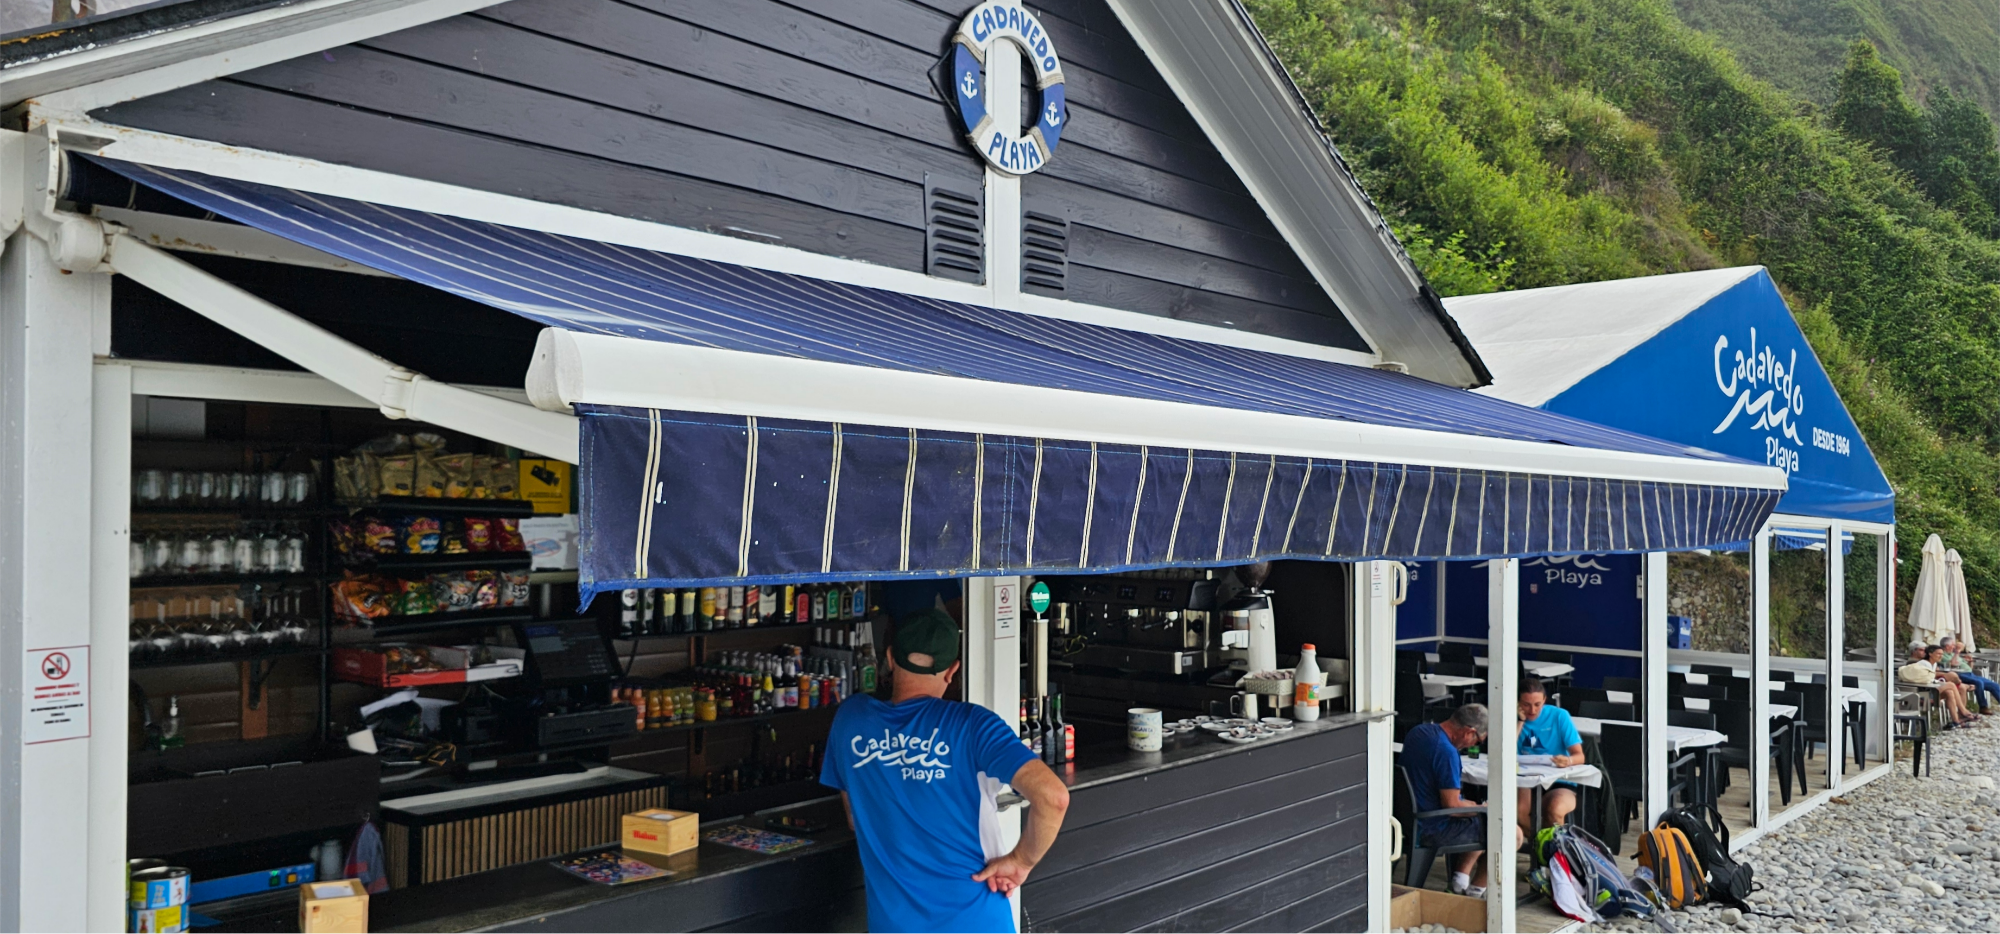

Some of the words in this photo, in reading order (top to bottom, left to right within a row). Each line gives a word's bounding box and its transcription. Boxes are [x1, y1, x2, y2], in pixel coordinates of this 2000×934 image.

[972, 5, 1056, 72] CADAVEDO
[988, 132, 1041, 170] PLAYA
[1714, 326, 1804, 416] Cadavedo
[1766, 436, 1799, 478] Playa
[1812, 426, 1835, 452] DESDE
[1835, 434, 1850, 457] 1964
[1544, 568, 1603, 588] Playa
[851, 727, 950, 757] Cadavedo
[901, 767, 946, 784] Playa
